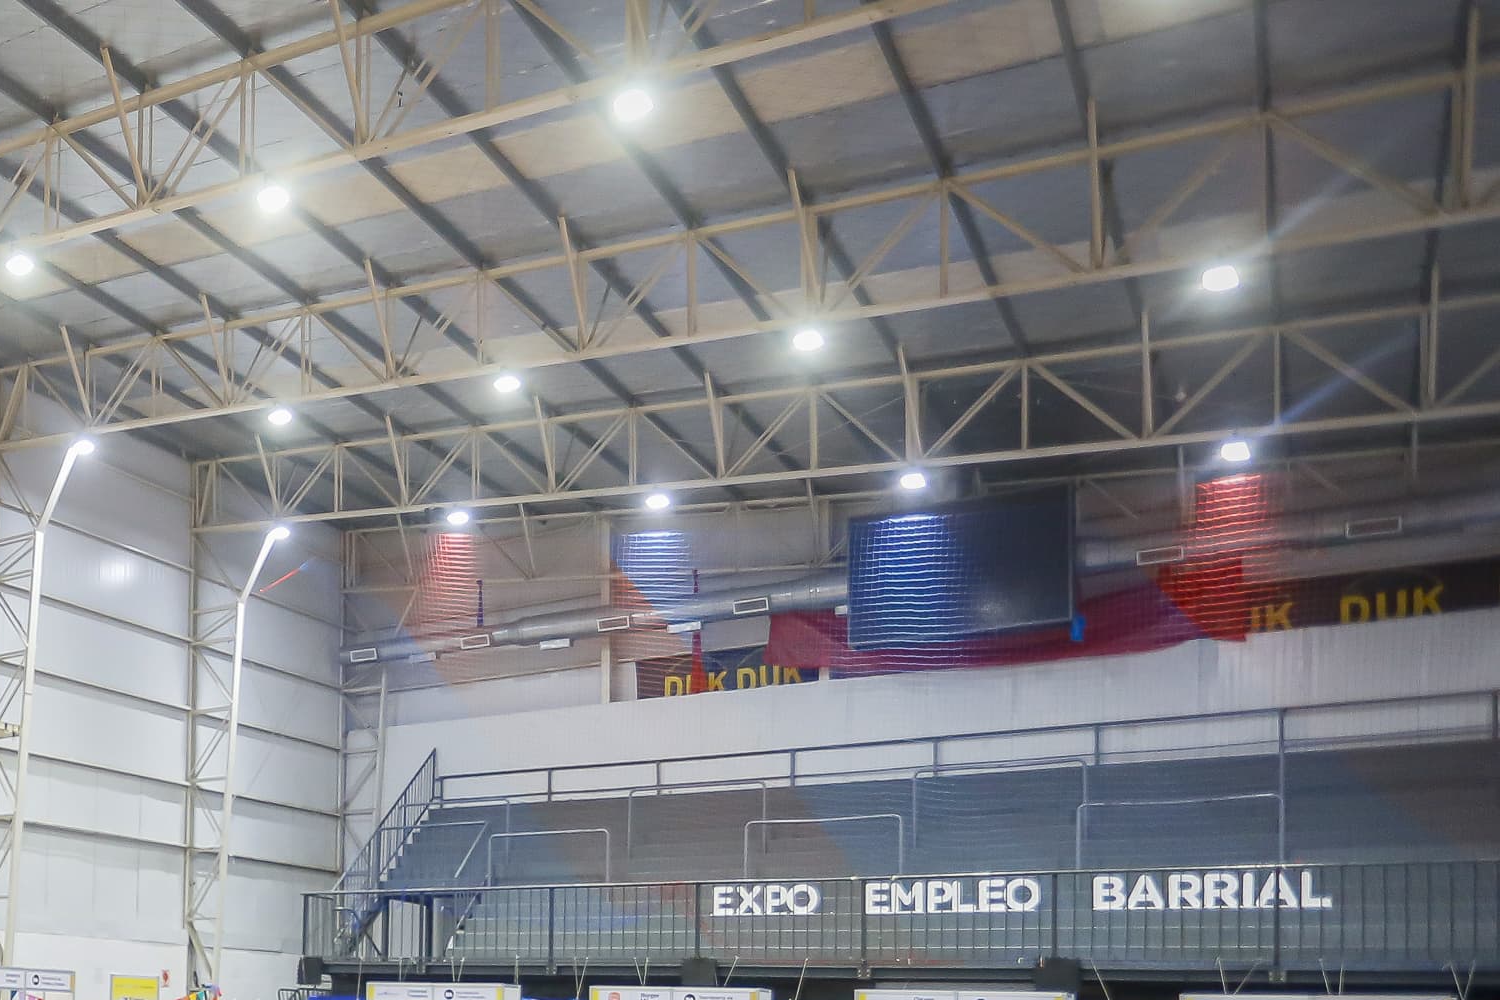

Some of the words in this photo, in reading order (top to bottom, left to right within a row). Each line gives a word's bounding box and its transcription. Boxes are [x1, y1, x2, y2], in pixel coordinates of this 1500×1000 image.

[712, 883, 822, 915] EXPO
[863, 877, 1041, 914] EMPLEO
[1092, 870, 1332, 910] BARRIAL
